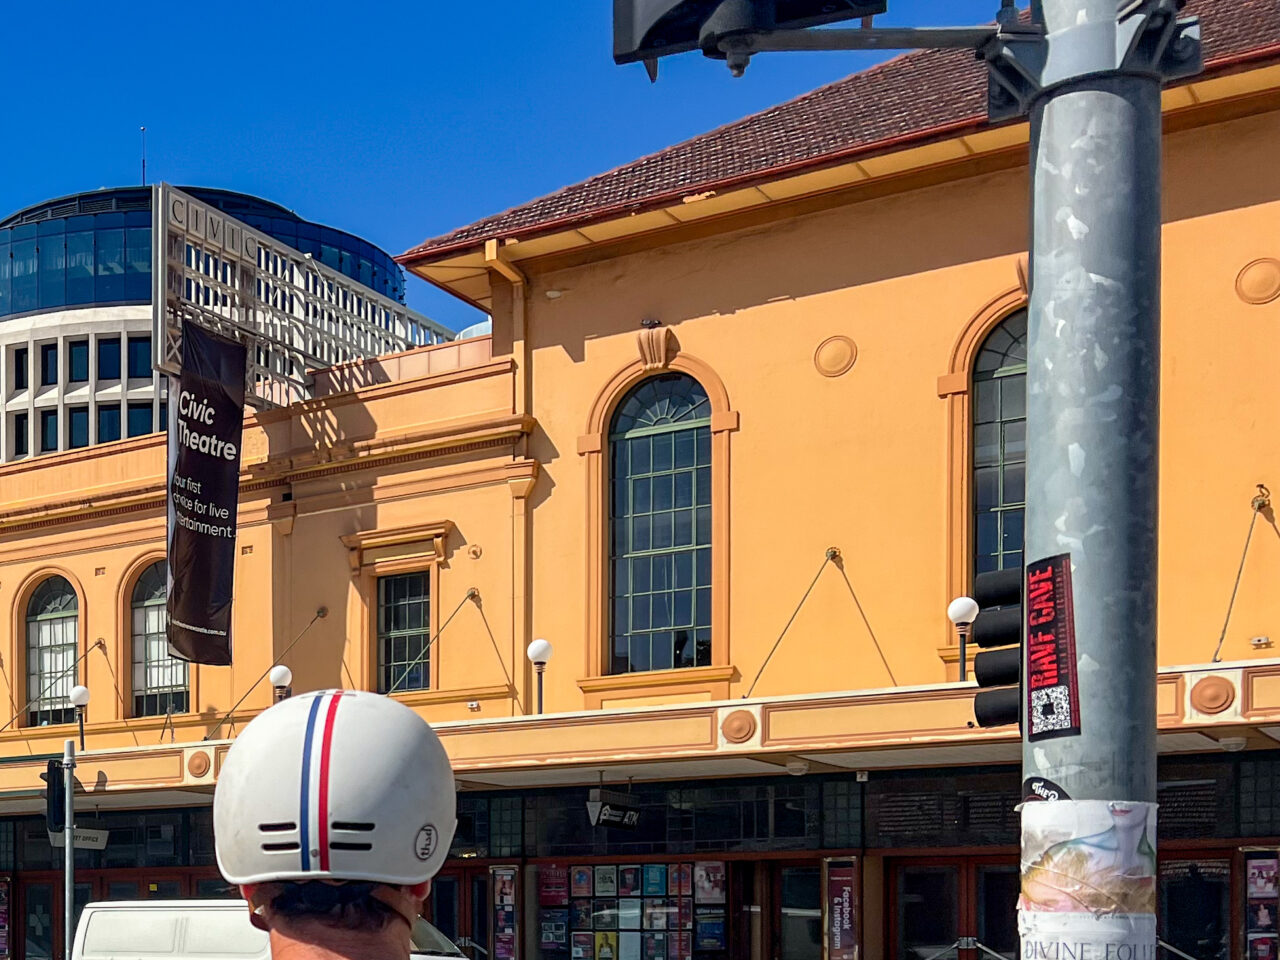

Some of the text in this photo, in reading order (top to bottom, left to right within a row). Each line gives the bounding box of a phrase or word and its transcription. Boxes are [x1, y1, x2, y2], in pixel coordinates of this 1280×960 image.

[172, 199, 257, 259] CIVIC
[179, 390, 216, 425] Civic
[177, 418, 237, 461] Theatre
[187, 476, 201, 494] first
[194, 499, 207, 514] for
[209, 502, 229, 519] live
[1029, 565, 1058, 688] RAVE CAVE
[1032, 781, 1050, 799] THE
[832, 905, 841, 950] Instagram
[842, 886, 852, 930] Facebook
[1025, 941, 1092, 960] DIVINE
